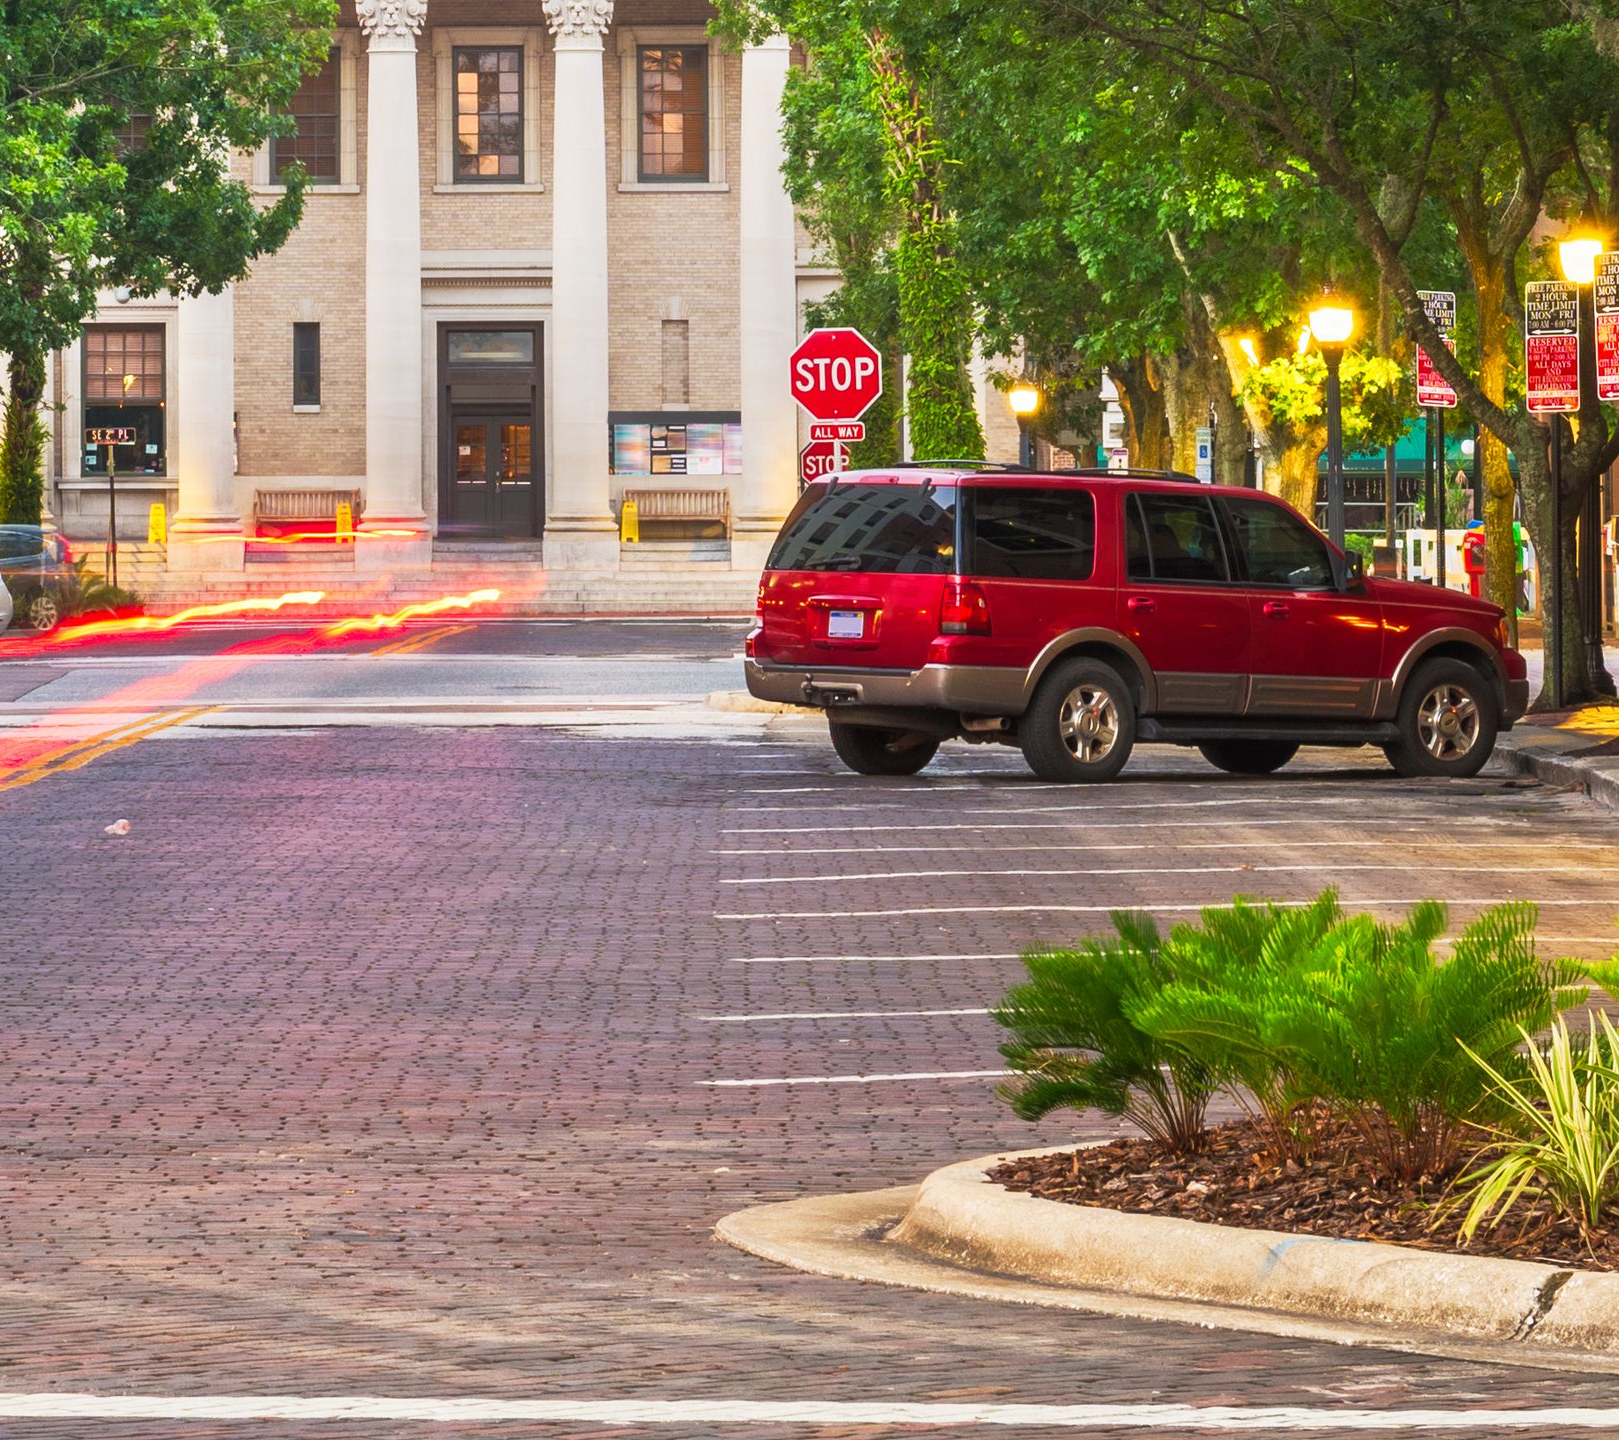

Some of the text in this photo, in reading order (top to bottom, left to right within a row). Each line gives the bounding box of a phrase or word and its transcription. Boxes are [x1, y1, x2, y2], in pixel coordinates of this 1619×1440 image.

[1596, 275, 1615, 285] TIME
[1598, 285, 1616, 296] MON
[1542, 292, 1568, 301] HOUR
[1528, 300, 1577, 311] TIME LIMIT
[1530, 311, 1551, 319] MON
[1559, 310, 1574, 319] FRI
[1529, 337, 1576, 346] RESERVED
[795, 356, 875, 392] STOP
[1535, 382, 1572, 390] HOLIDAYS
[91, 430, 102, 440] SE
[118, 429, 129, 439] PL
[814, 427, 859, 438] ALL WAY
